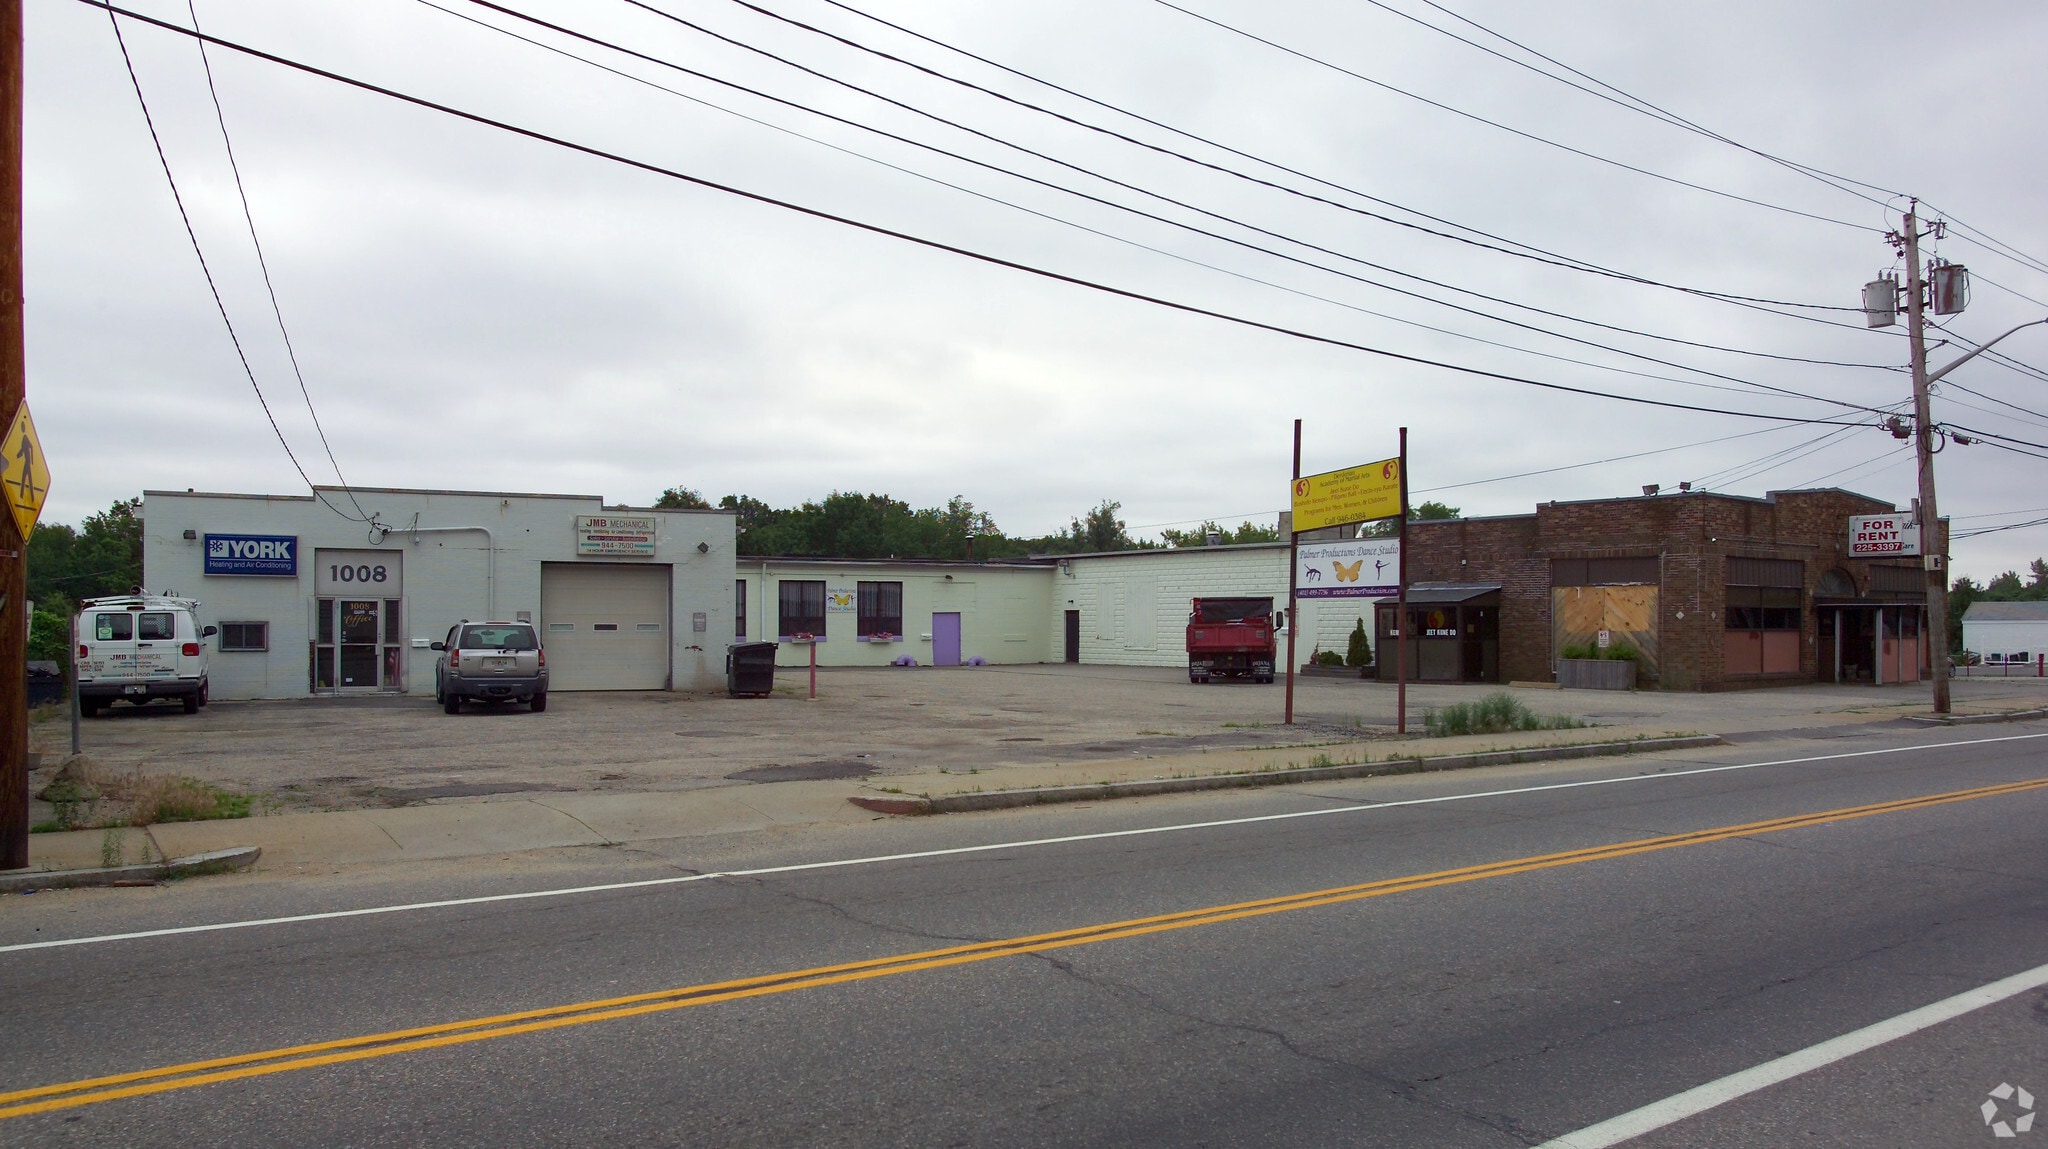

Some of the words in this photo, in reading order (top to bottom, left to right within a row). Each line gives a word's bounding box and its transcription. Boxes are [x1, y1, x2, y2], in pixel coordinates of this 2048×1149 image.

[586, 519, 607, 527] JMB
[1325, 516, 1336, 526] Call
[1863, 520, 1893, 530] FOR
[1858, 531, 1898, 541] RENT
[230, 540, 291, 559] YORK
[1300, 547, 1320, 559] Palmer
[1321, 547, 1356, 558] Productions
[1357, 546, 1377, 556] Dance
[1378, 544, 1398, 556] Studio
[1856, 543, 1900, 552] 225-3397
[256, 562, 291, 570] Conditioning
[330, 565, 387, 582] 1008
